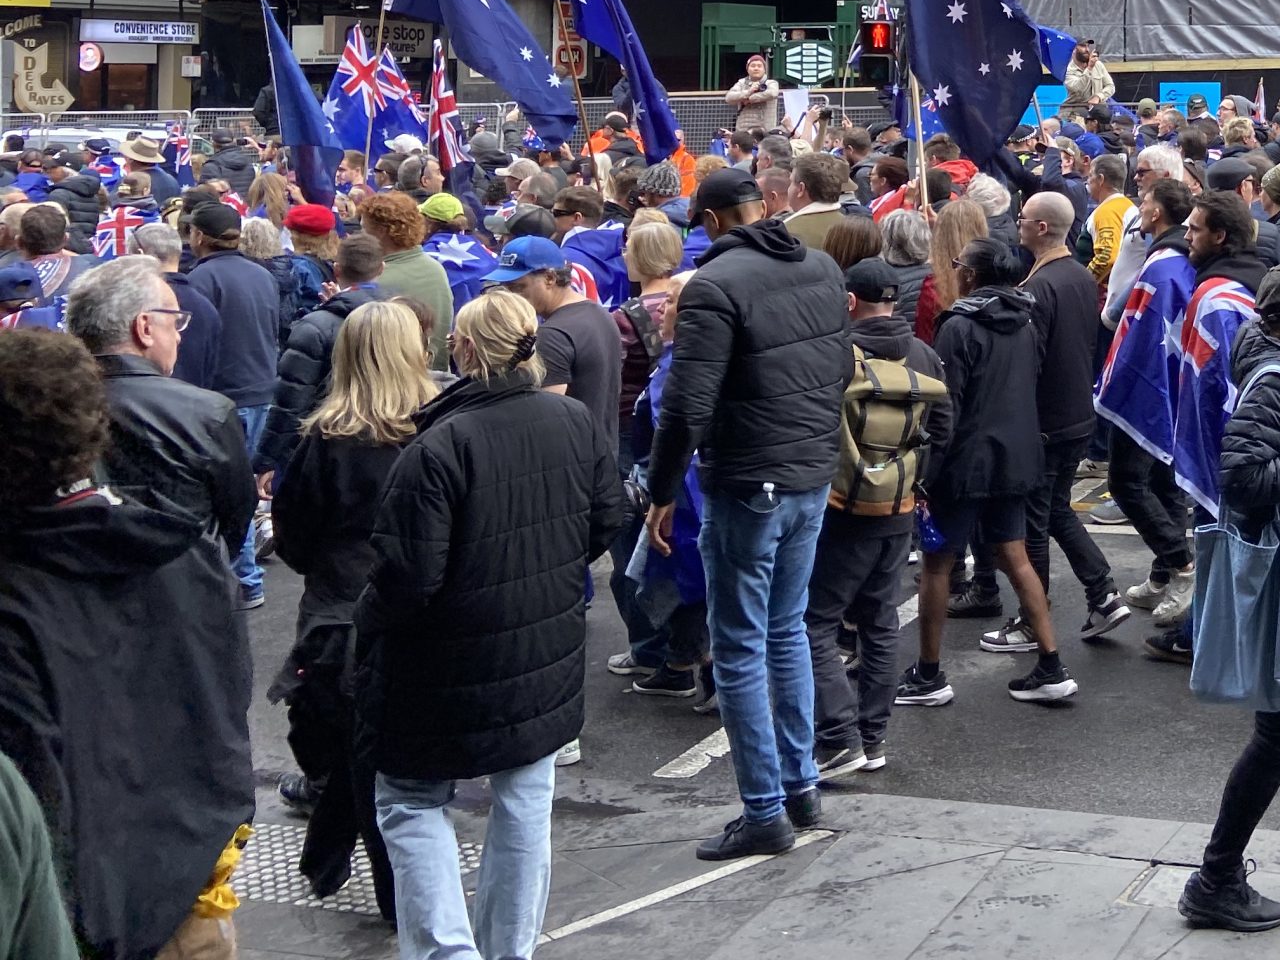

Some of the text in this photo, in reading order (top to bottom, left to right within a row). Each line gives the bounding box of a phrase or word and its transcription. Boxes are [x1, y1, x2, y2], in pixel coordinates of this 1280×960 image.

[114, 22, 196, 35] CONVENIENCE STORE
[393, 24, 425, 46] stop
[23, 38, 36, 48] TO
[560, 50, 580, 63] WX
